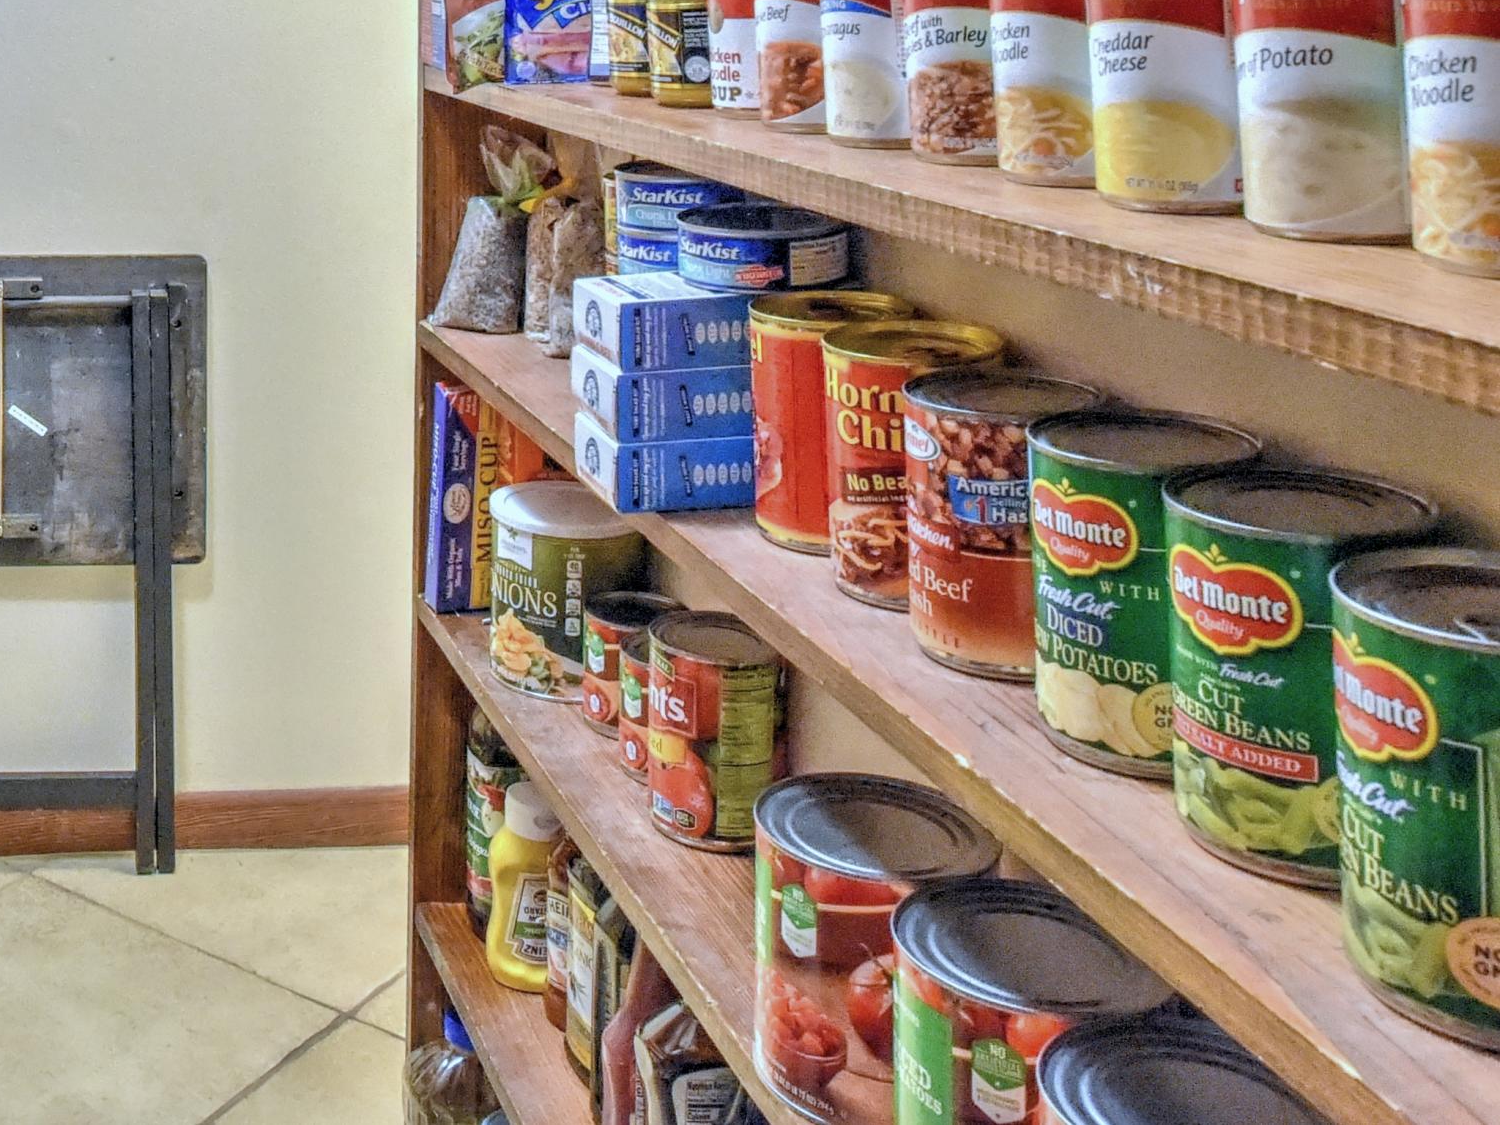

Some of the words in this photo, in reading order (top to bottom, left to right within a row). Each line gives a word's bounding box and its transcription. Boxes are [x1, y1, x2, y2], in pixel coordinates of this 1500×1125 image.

[936, 26, 988, 48] Barley
[1259, 46, 1333, 70] Potato
[632, 187, 703, 205] StarKist
[618, 240, 672, 263] StarKist
[679, 236, 741, 261] StarKist
[847, 473, 869, 492] No
[872, 473, 907, 491] Bea
[991, 506, 1028, 524] Has
[1056, 512, 1127, 548] Monte
[1050, 535, 1090, 562] Quality
[924, 563, 973, 604] Beef
[1100, 579, 1161, 601] WITH
[1174, 564, 1200, 602] Del
[1202, 579, 1289, 624] Monte
[910, 589, 933, 618] ash
[1046, 602, 1103, 648] DICED
[1195, 608, 1245, 641] Quality
[1051, 635, 1159, 686] POTATOES
[1197, 678, 1246, 716] CUT
[1346, 671, 1424, 734] Monte
[1172, 681, 1218, 727] GREEN
[1225, 710, 1311, 752] BEANS
[1232, 746, 1301, 773] ADDED
[1390, 769, 1469, 812] WITH
[1342, 804, 1385, 861] CUT
[1363, 854, 1460, 926] BEANS
[523, 944, 547, 958] EINZ
